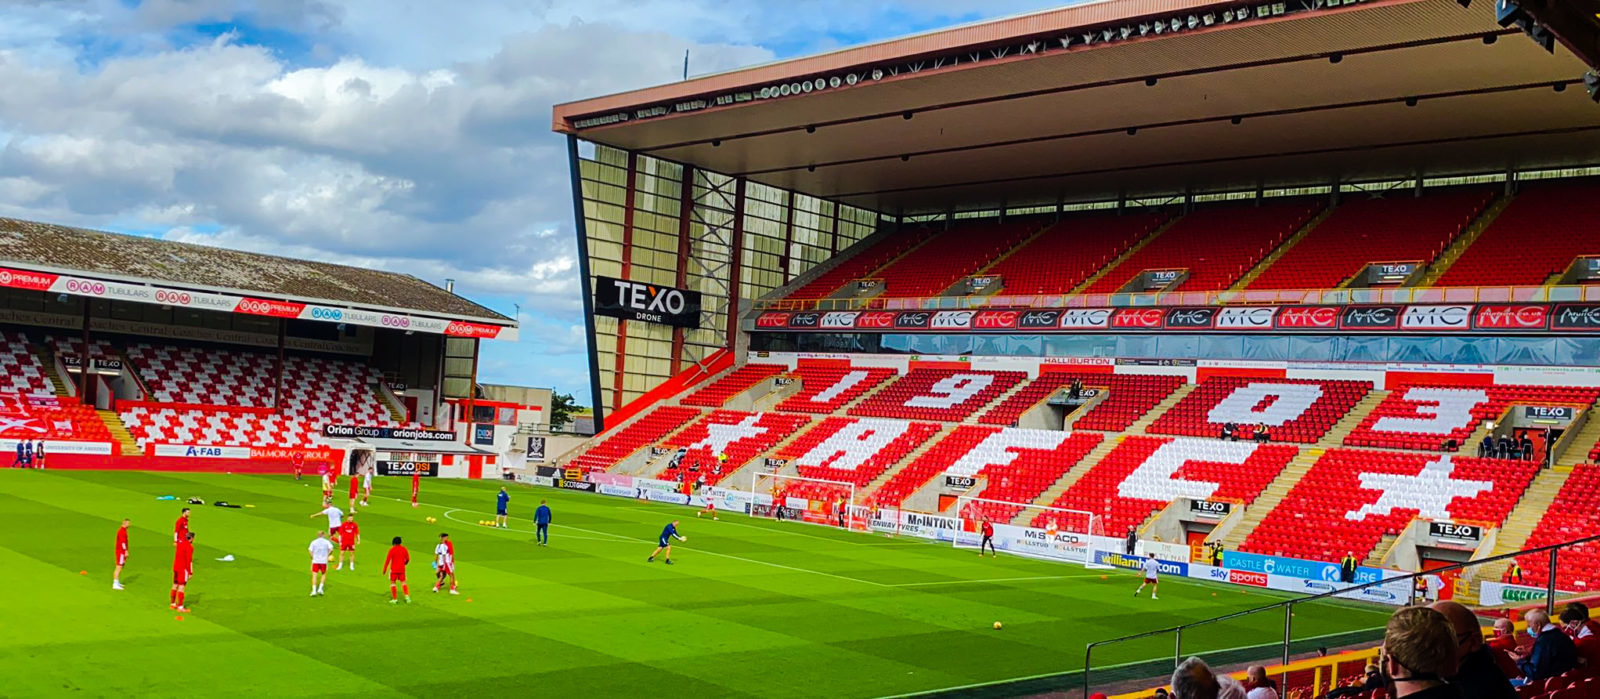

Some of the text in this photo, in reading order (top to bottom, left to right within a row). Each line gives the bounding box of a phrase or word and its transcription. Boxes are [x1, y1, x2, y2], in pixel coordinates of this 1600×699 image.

[1383, 265, 1407, 273] TEXO
[13, 274, 51, 285] PREMIUM
[1155, 271, 1176, 279] TEXO
[66, 279, 105, 295] RAM
[108, 286, 149, 298] TUBULARS
[155, 289, 231, 307] RAM TUBULARS
[614, 280, 685, 315] TEXO
[344, 313, 376, 324] TUBULARS
[636, 312, 662, 323] DRONE
[65, 356, 81, 365] TEX
[1044, 357, 1110, 365] HALLIBURTON
[1079, 389, 1094, 397] EXO
[1533, 407, 1564, 416] TEXO
[327, 424, 454, 441] Orion Group orionjobs.com
[387, 461, 414, 471] TEXO
[768, 458, 785, 466] TEXO
[951, 477, 971, 486] TEXO
[1197, 501, 1224, 511] TEXO
[1438, 523, 1472, 537] TEXO
[1230, 557, 1261, 569] CASTLE
[1276, 563, 1308, 577] WATER
[1211, 568, 1266, 585] sky sports
